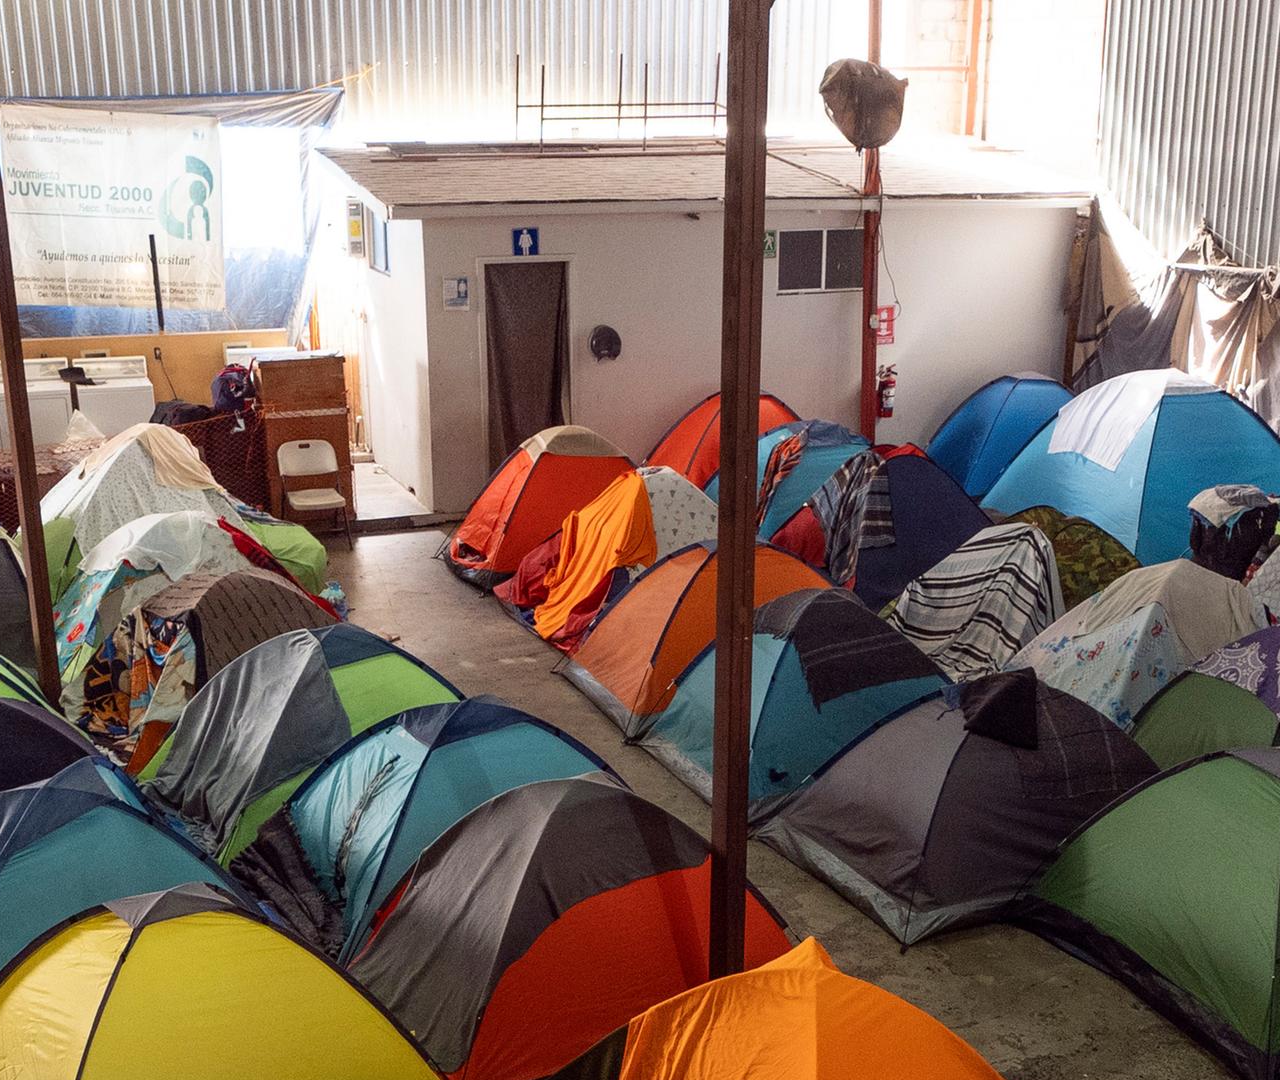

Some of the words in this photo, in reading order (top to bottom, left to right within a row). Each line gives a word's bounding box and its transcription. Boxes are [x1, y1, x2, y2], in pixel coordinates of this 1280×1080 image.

[7, 167, 61, 180] Movimiento
[8, 180, 102, 200] JUVENTUD
[109, 186, 153, 202] 2000
[91, 254, 97, 262] a
[99, 252, 132, 265] quienes
